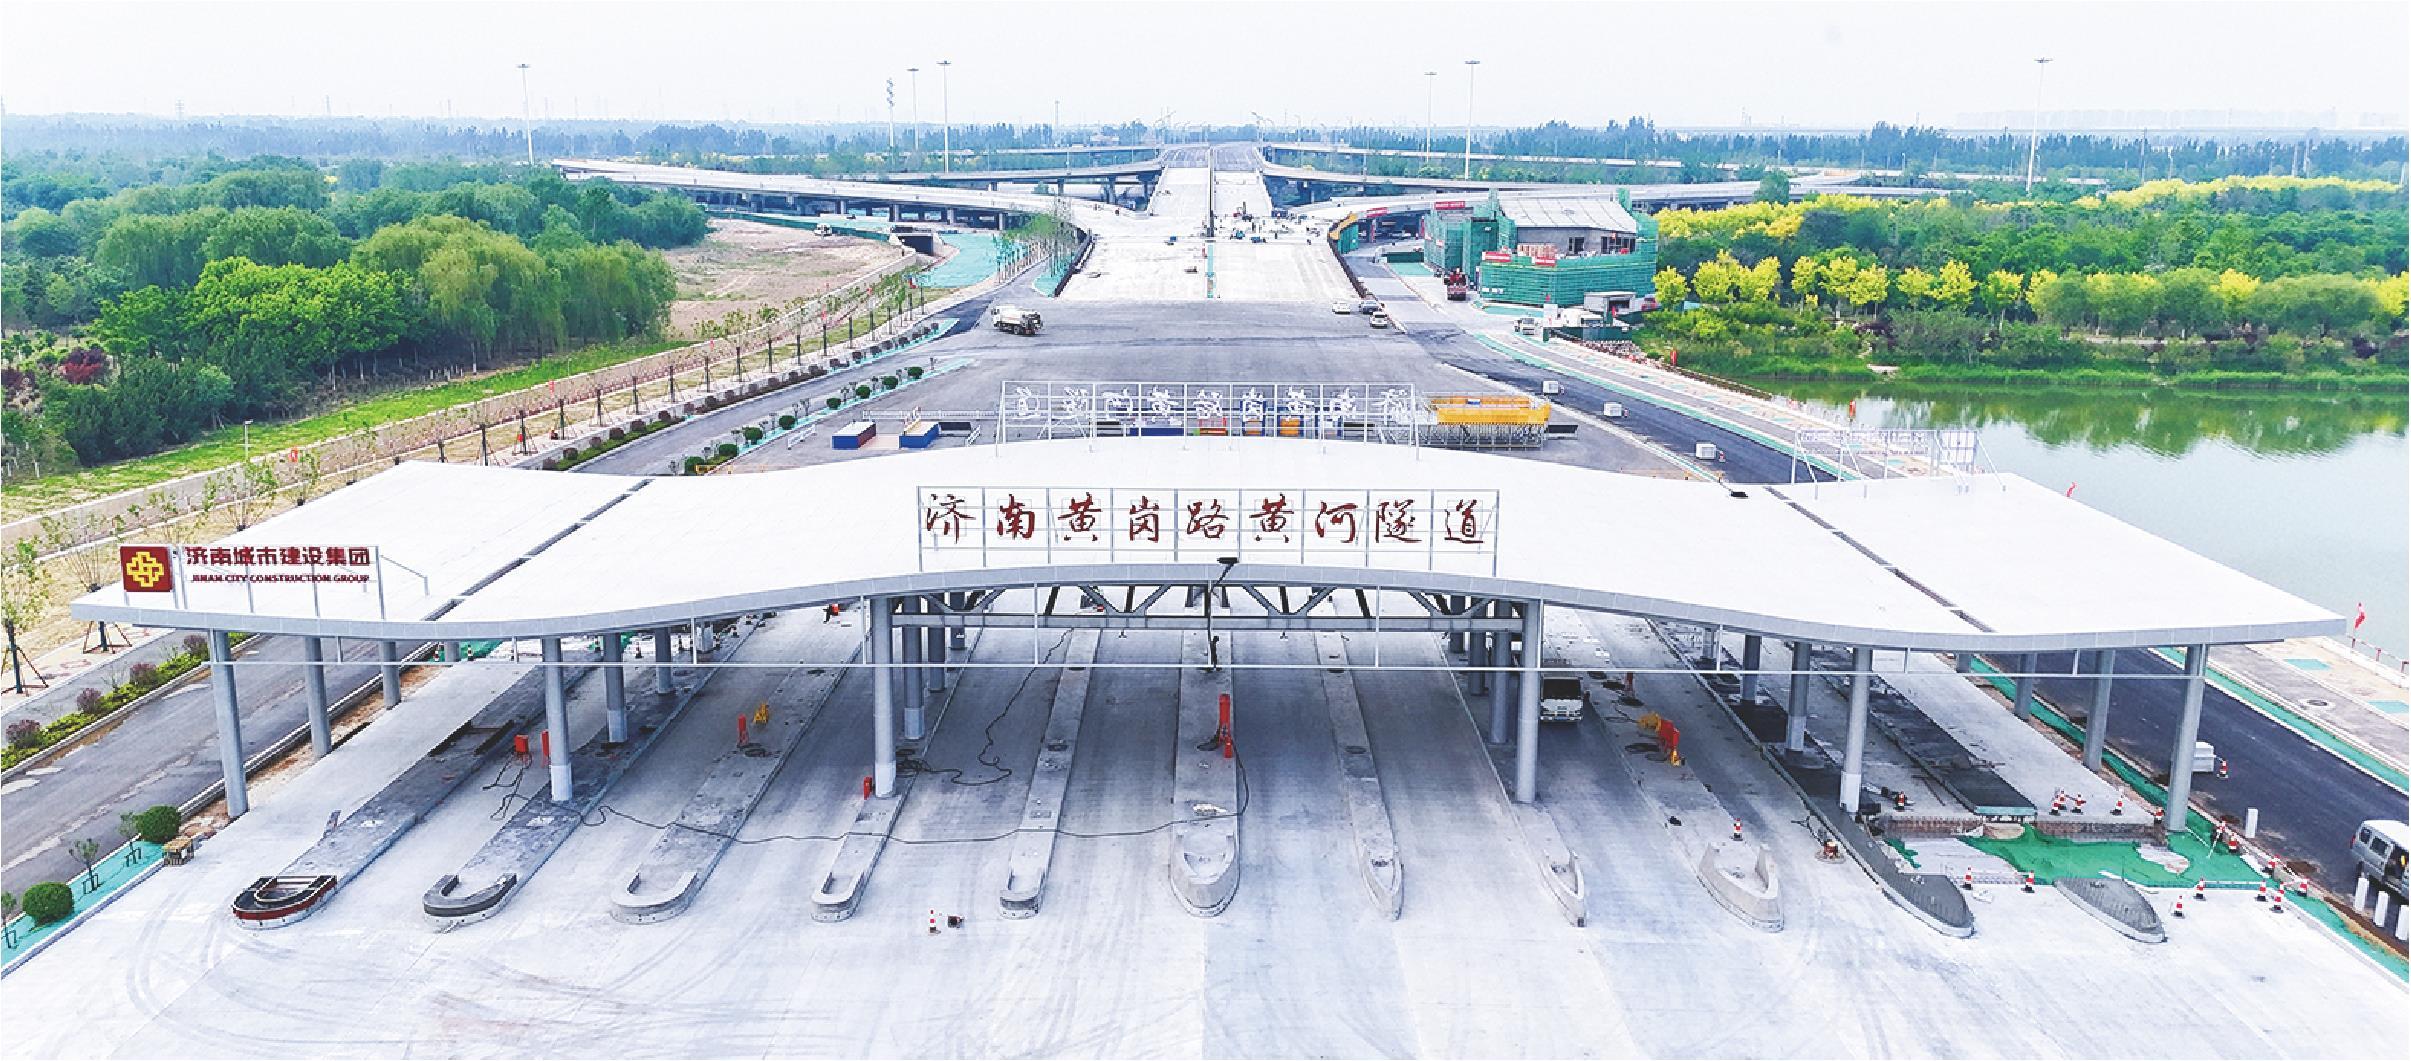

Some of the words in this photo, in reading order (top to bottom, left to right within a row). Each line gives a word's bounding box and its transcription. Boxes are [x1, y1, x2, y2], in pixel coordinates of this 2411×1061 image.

[926, 492, 1484, 544] 济南黄岗路黄河隧道
[185, 546, 371, 567] 济南城市建设集团
[224, 574, 248, 583] CITY
[249, 574, 331, 583] CONSTRUCTION
[333, 574, 370, 583] GROUP
